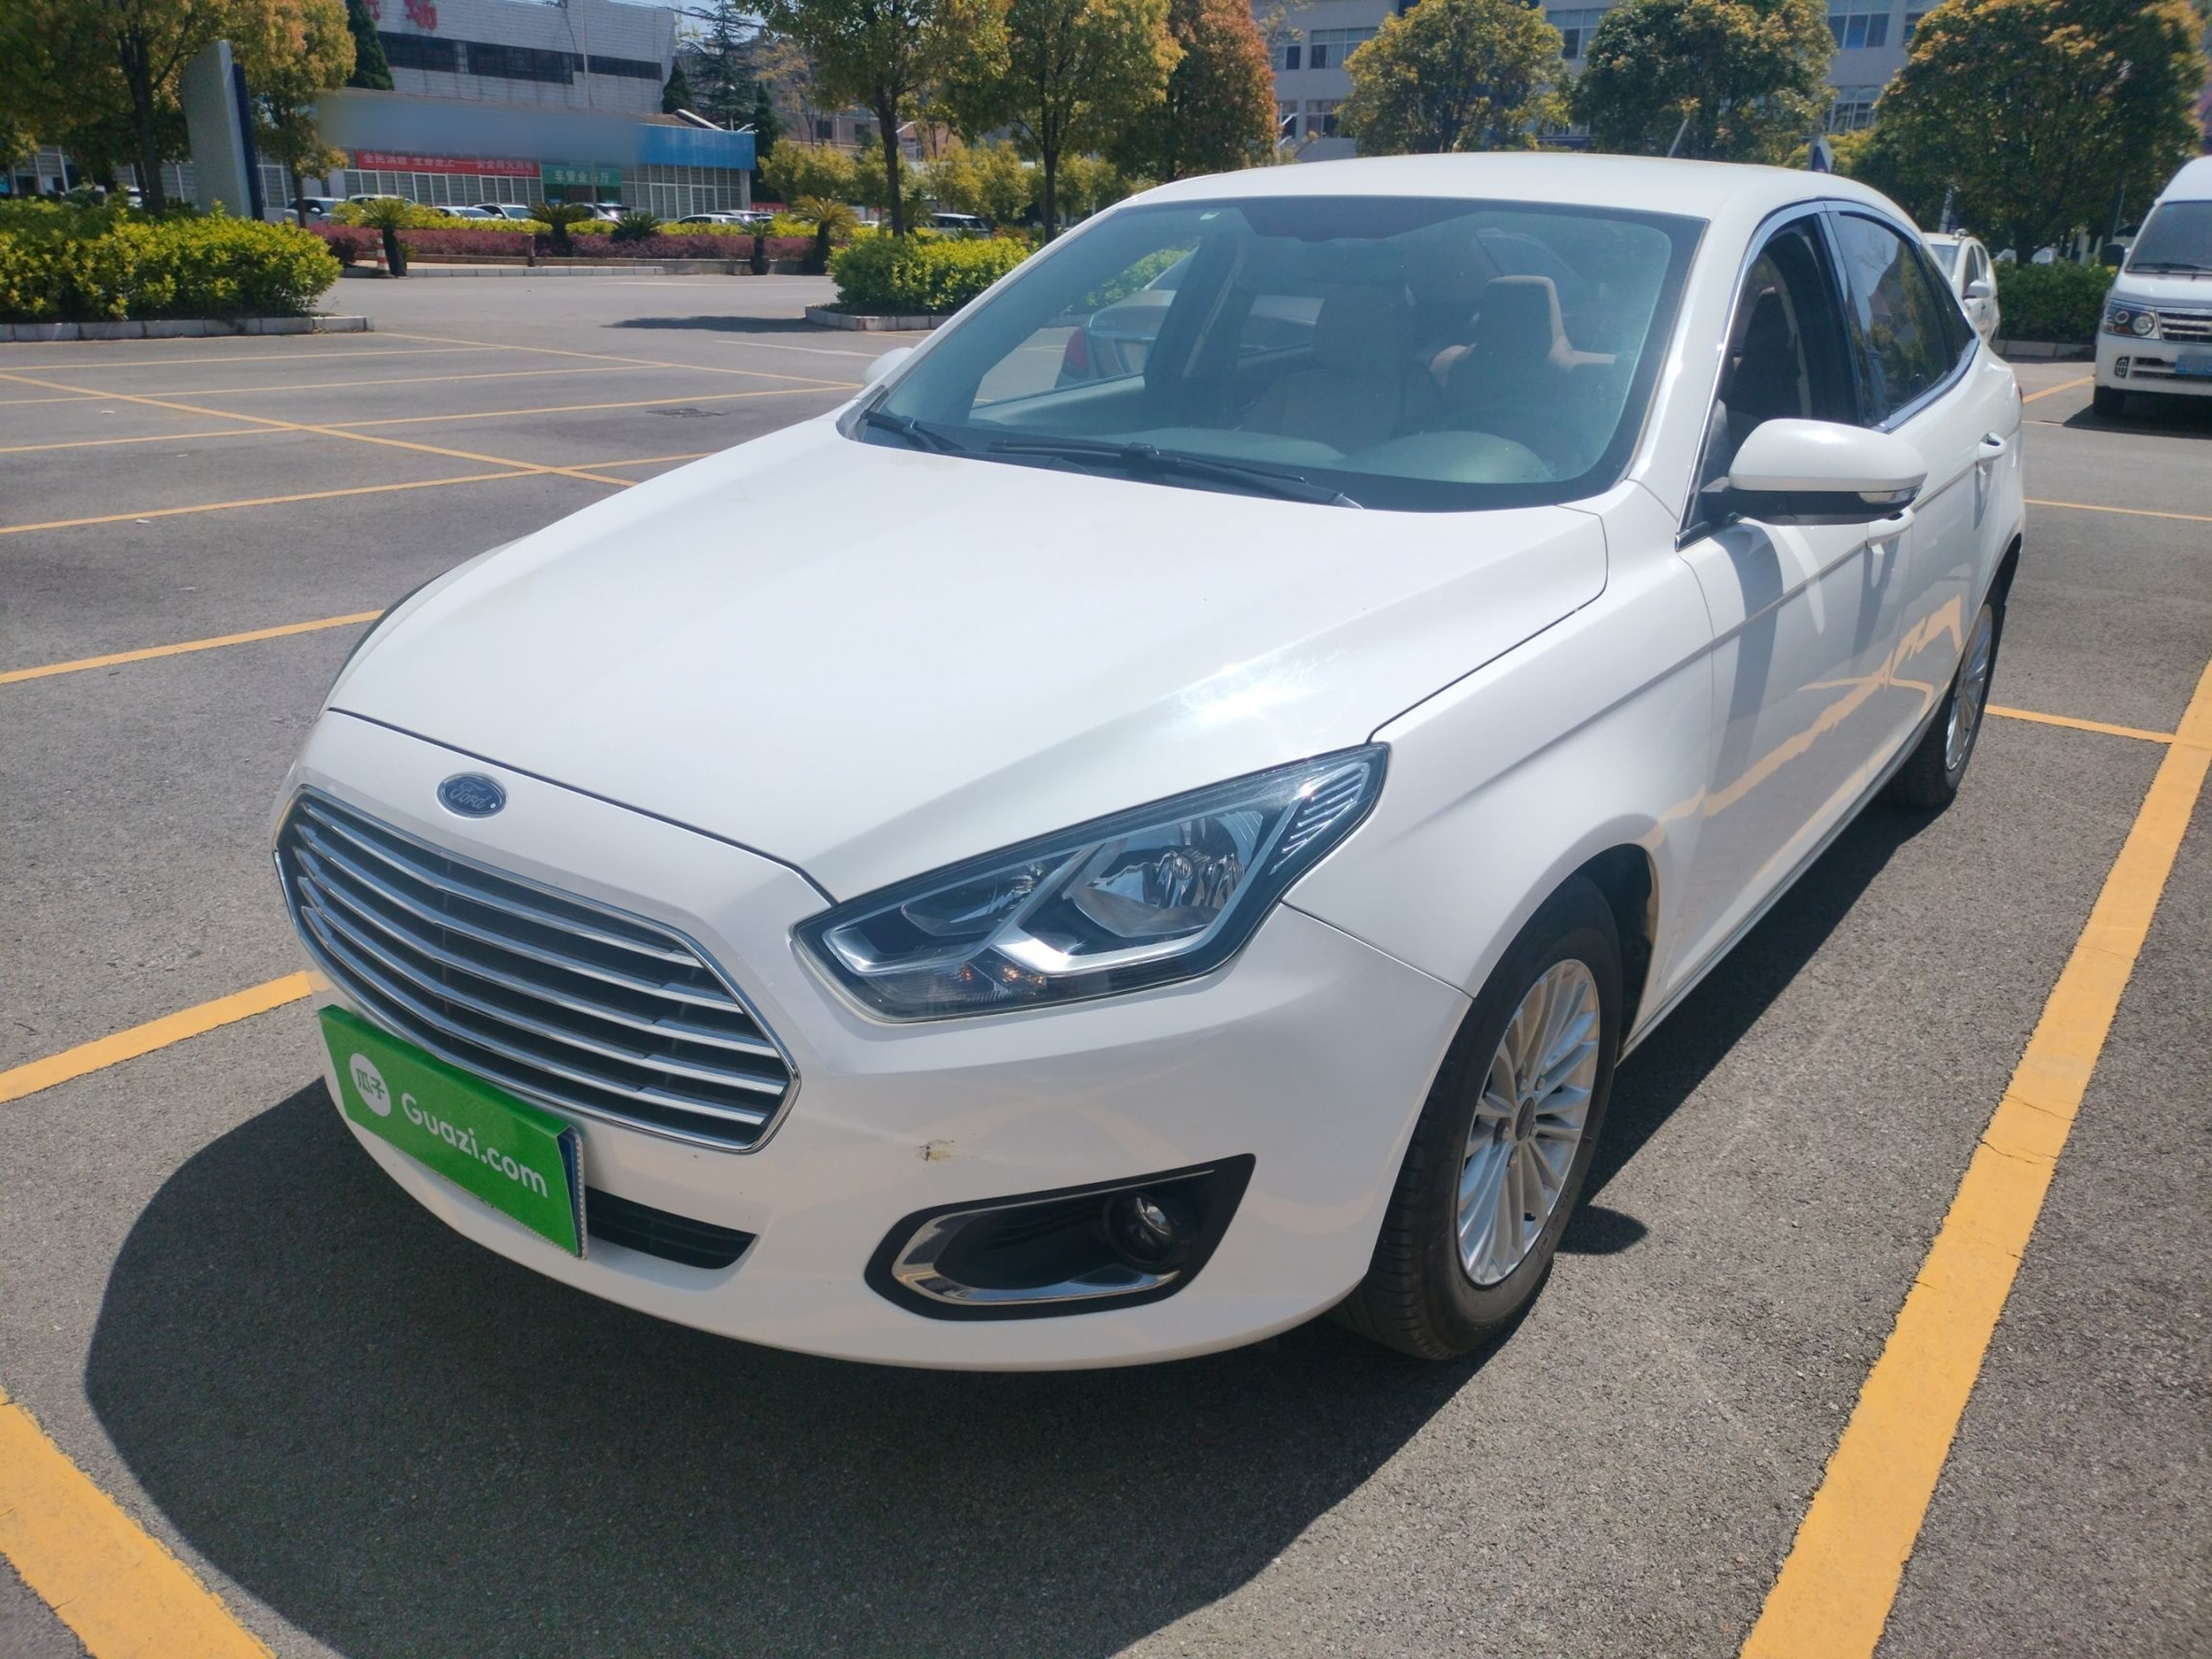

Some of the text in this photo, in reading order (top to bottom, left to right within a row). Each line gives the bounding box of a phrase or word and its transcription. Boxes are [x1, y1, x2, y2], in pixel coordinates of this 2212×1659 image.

[449, 781, 493, 809] Ford
[356, 1068, 385, 1100] 瓜子
[401, 1093, 548, 1198] Guazi.com
